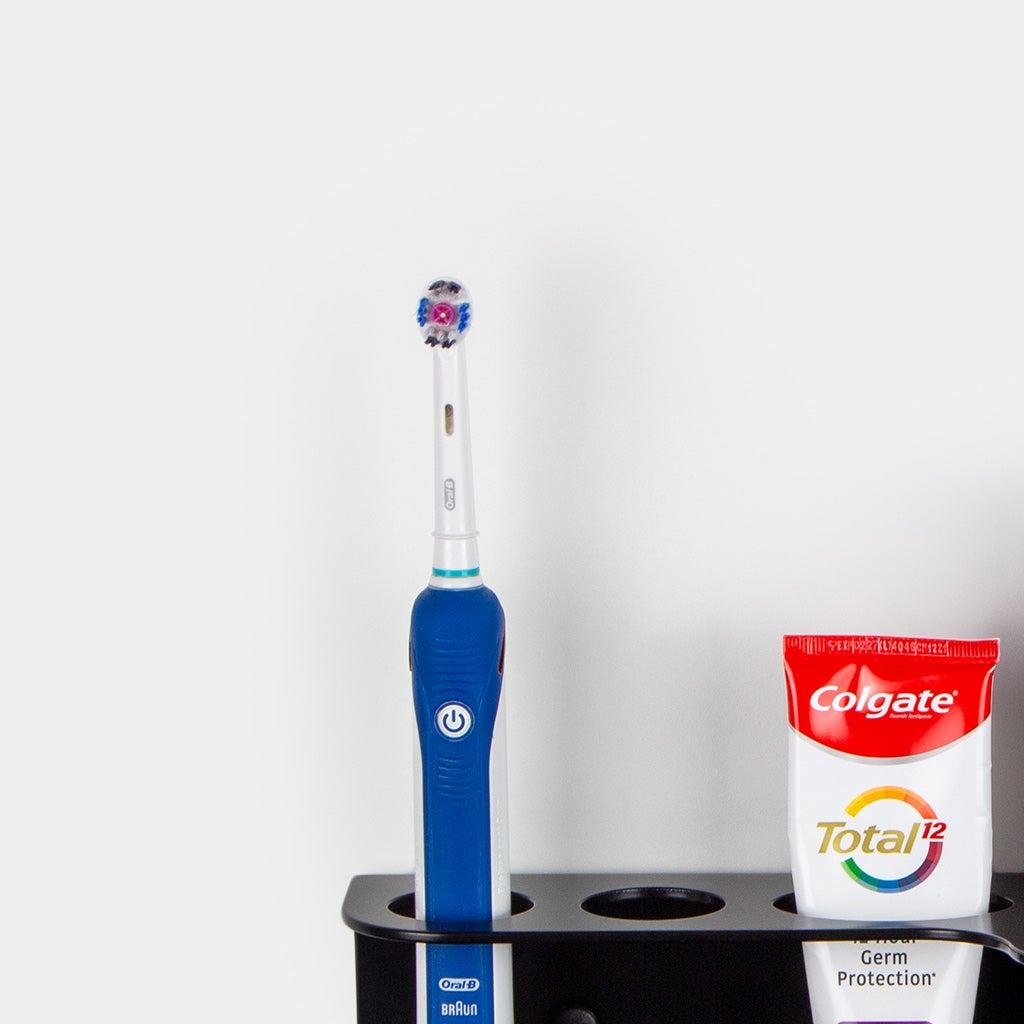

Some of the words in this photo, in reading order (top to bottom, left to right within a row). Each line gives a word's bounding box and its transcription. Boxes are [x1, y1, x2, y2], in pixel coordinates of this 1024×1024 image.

[809, 685, 954, 719] Colgate
[816, 821, 921, 855] Total
[921, 822, 947, 840] 12
[861, 950, 908, 965] Germ
[441, 979, 477, 990] Oral-B
[442, 1000, 478, 1016] BRAUN
